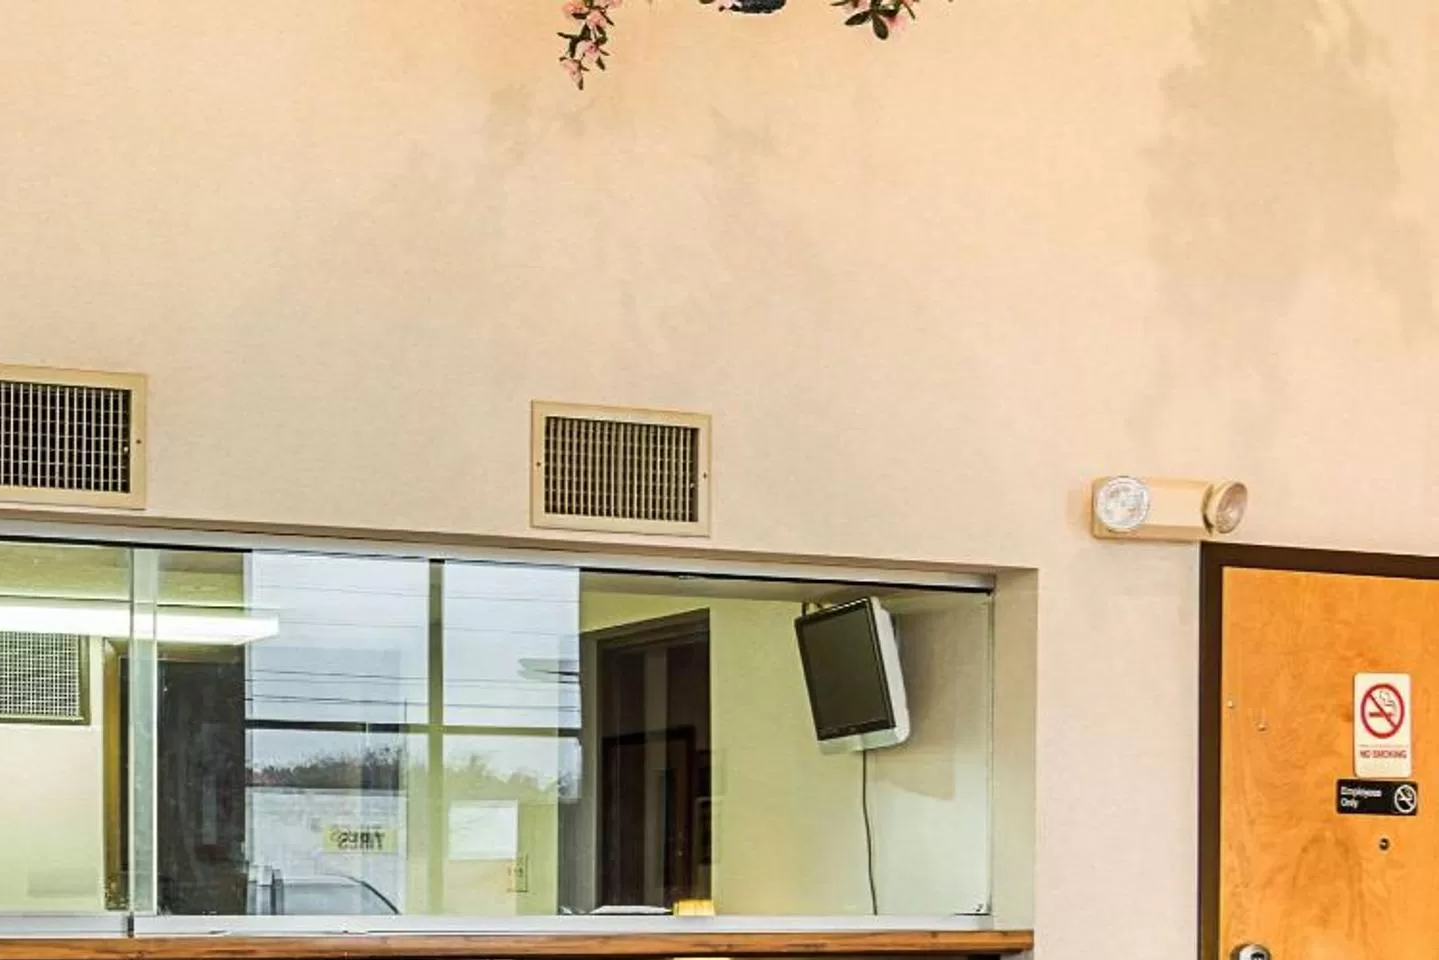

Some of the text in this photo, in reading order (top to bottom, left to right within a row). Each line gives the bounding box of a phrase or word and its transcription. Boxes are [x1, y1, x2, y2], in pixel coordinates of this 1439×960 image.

[1360, 750, 1408, 759] NO SMOKING
[1340, 786, 1382, 799] Employees
[1340, 798, 1358, 809] Only
